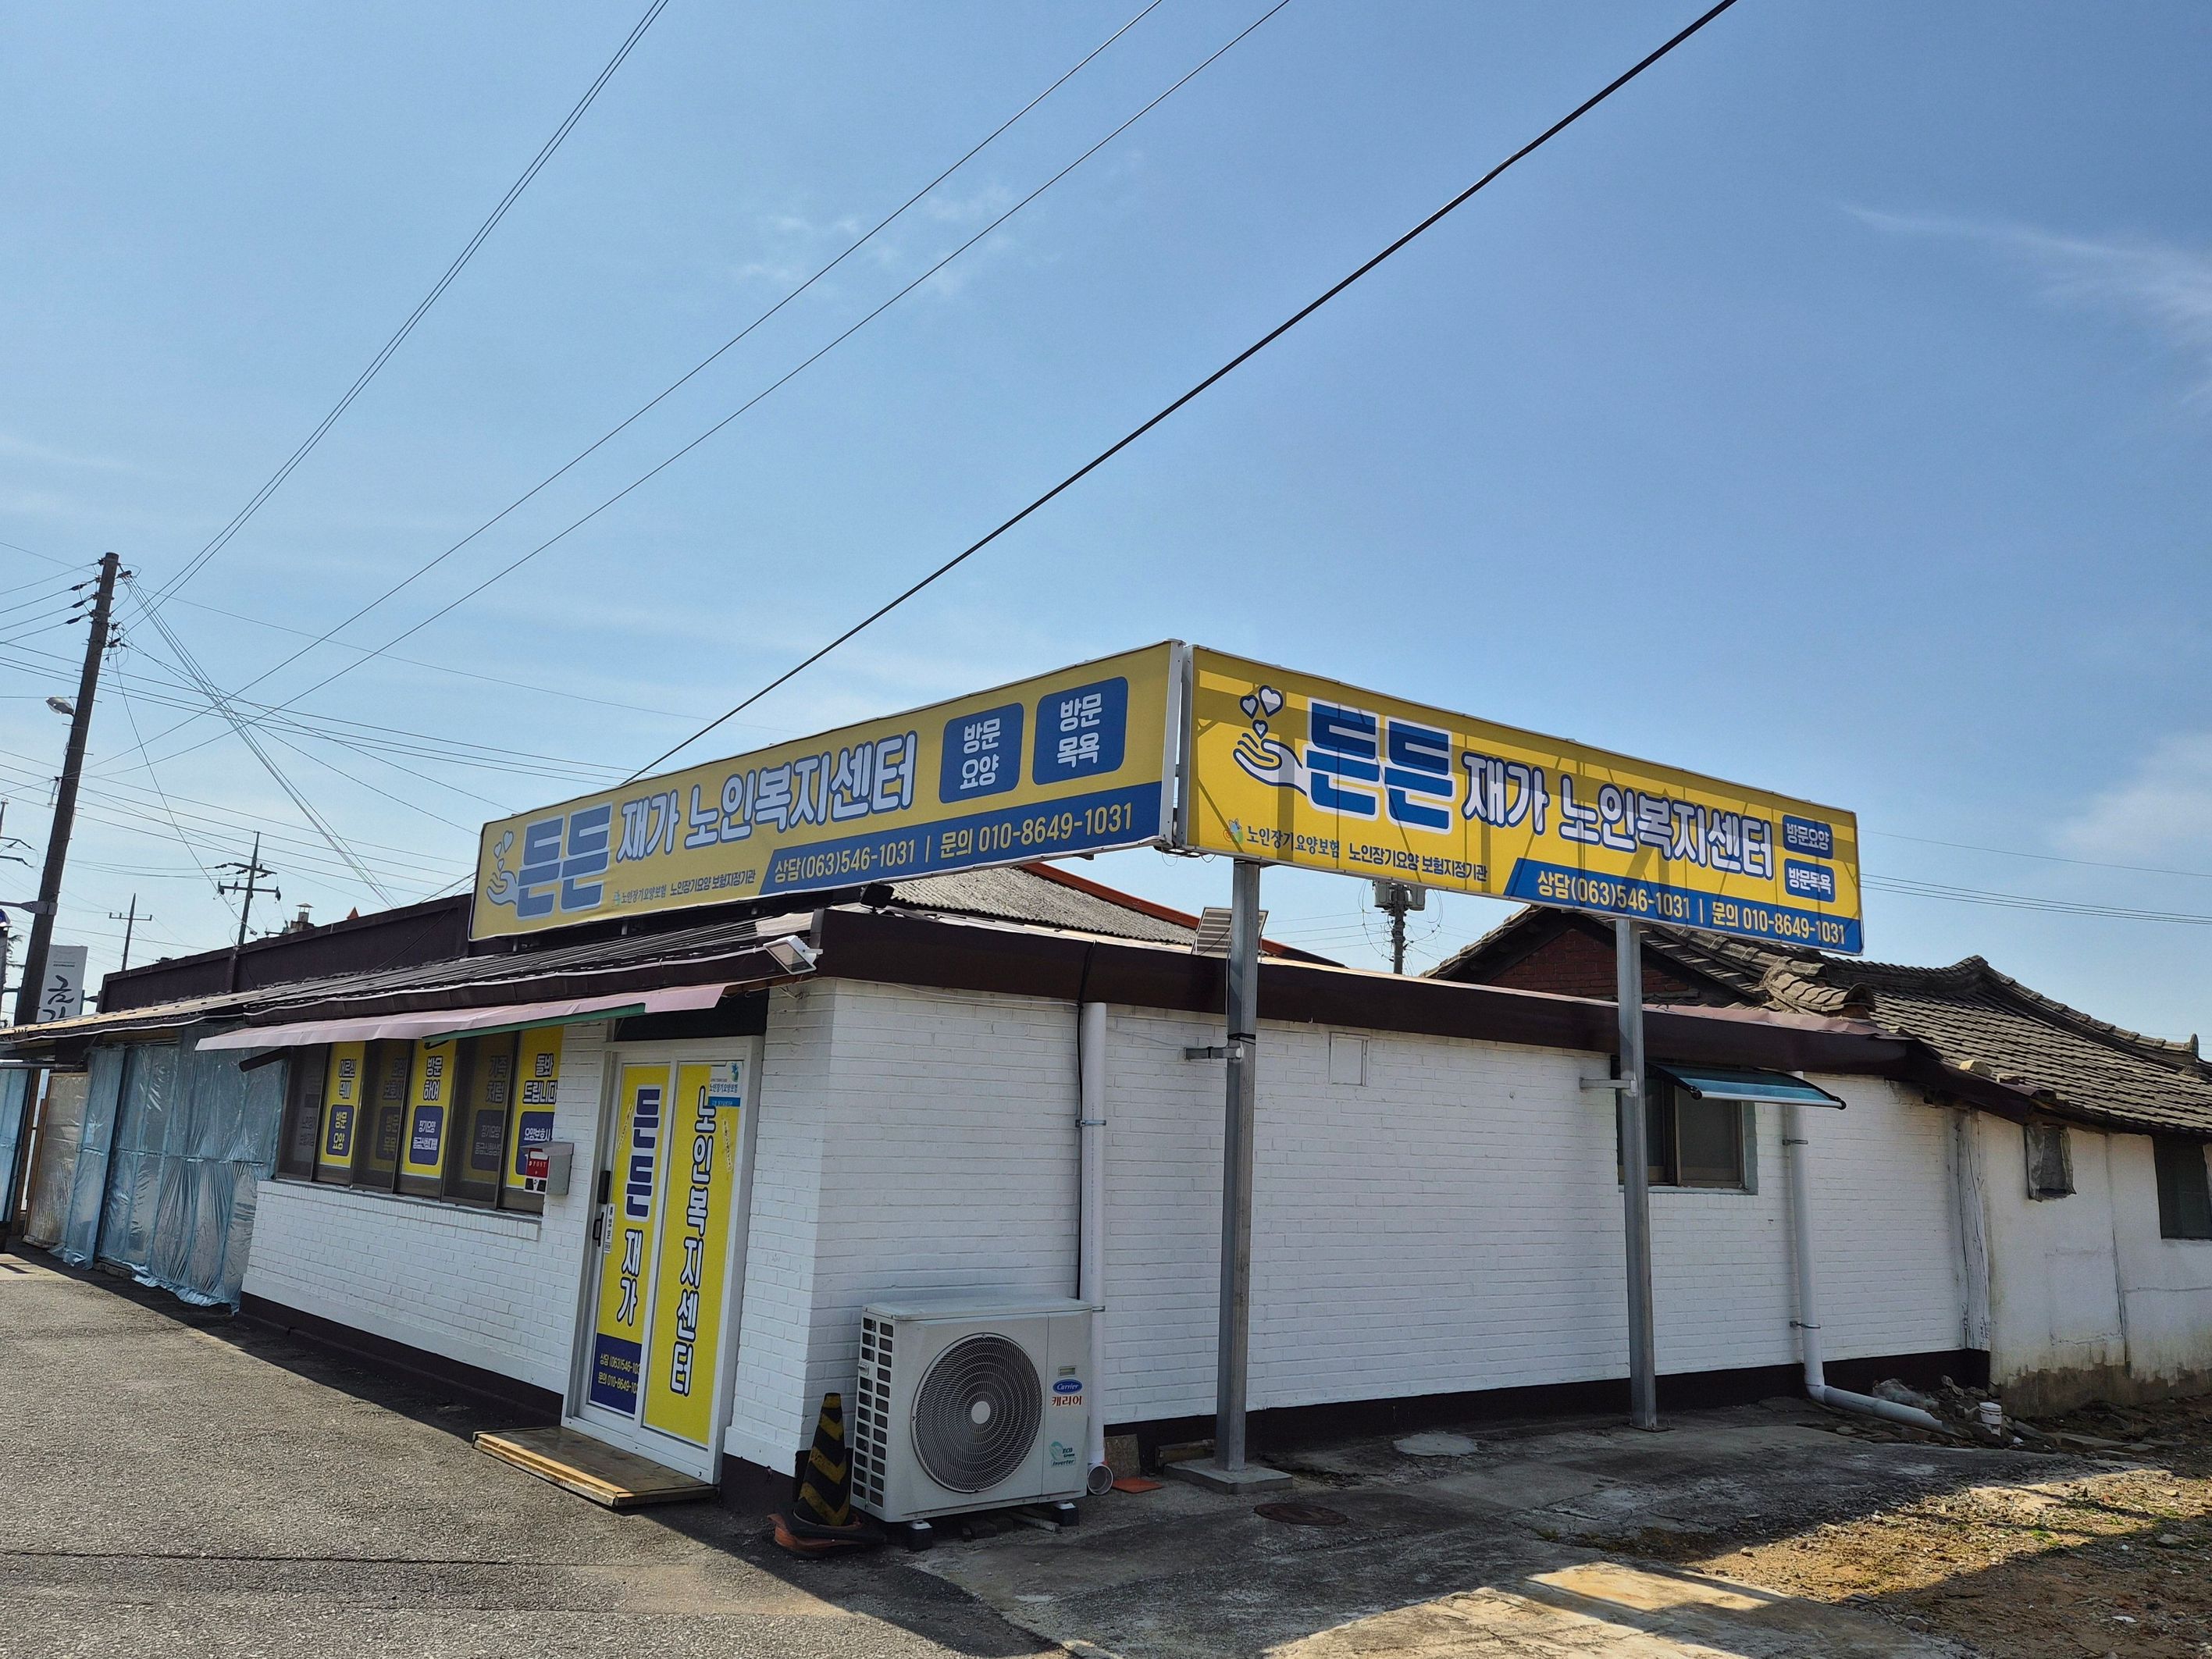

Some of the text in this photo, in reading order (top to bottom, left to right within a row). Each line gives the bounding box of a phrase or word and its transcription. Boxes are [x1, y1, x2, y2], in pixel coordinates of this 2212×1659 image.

[1060, 692, 1102, 732] 방문
[964, 717, 1000, 754] 방문
[1056, 732, 1099, 768] 목욕
[959, 754, 999, 791] 요양
[1304, 698, 1774, 881] 든든 재가 노인복지센터
[516, 728, 917, 920] 든든 재가 노인복지센터
[940, 828, 973, 859] 문의
[979, 802, 1132, 850] 010-8649-1031
[1786, 823, 1830, 851] 방문요양
[1247, 826, 1340, 859] 노인장기요양보험
[1349, 843, 1487, 882] 노인장기요양 보험지정기관
[621, 884, 667, 904] 노인장기요양보험
[670, 870, 757, 896] 노인장기요양 보험지정기관
[1788, 867, 1832, 895] 방문목욕
[1712, 901, 1739, 928] 문의
[1743, 906, 1845, 945] 010-8649-1031
[339, 1059, 356, 1078] 어르신
[426, 1056, 443, 1077] 방문
[489, 1056, 508, 1078] 가족
[536, 1053, 554, 1077] 돌봐
[423, 1080, 440, 1101] 하여
[486, 1080, 505, 1104] 처럼
[335, 1111, 347, 1129] 방문
[333, 1133, 345, 1151] 요양
[625, 1086, 661, 1220] 든든
[669, 1085, 716, 1397] 노인복지센터
[617, 1230, 643, 1326] 재가
[600, 1353, 609, 1366] 상담
[1052, 1396, 1082, 1406] 캐리어
